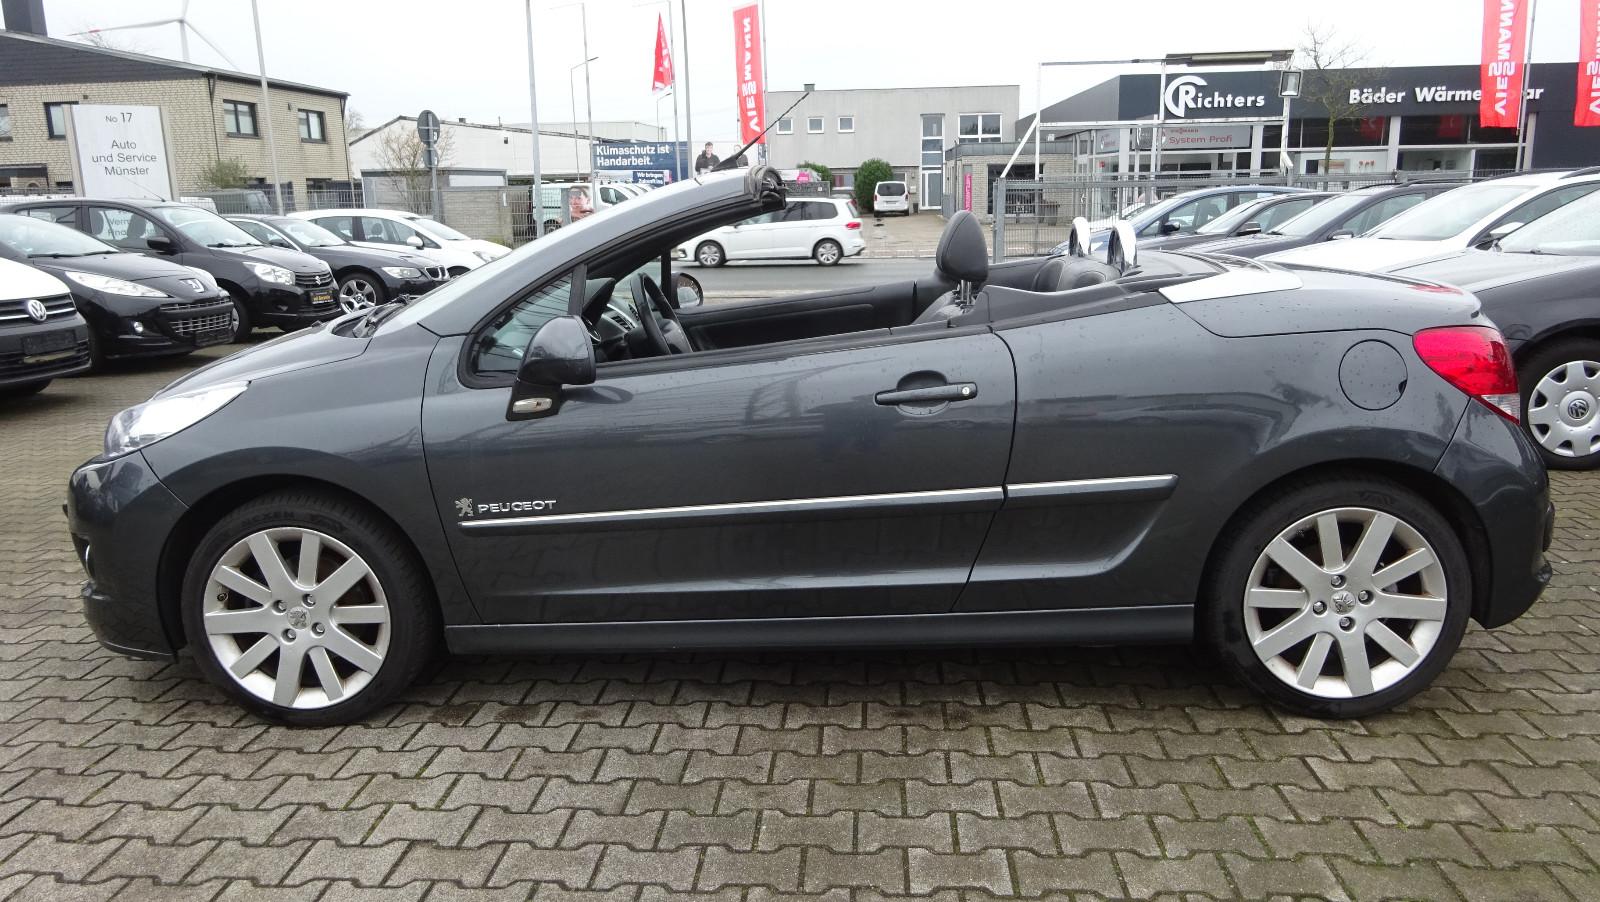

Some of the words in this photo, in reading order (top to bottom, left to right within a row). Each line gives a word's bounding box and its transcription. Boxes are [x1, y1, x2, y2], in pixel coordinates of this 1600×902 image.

[1348, 86, 1406, 104] Bäder
[1415, 86, 1481, 102] Wärme
[120, 112, 133, 123] 17
[111, 139, 137, 150] Auto
[1169, 136, 1206, 145] System
[1209, 134, 1233, 143] Profi
[596, 144, 655, 155] Klimaschutz
[657, 144, 670, 154] ist
[91, 153, 114, 163] und
[117, 152, 157, 163] Service
[597, 156, 653, 166] Handarbeit.
[104, 166, 150, 176] Münster
[477, 499, 557, 514] PEUGEOT
